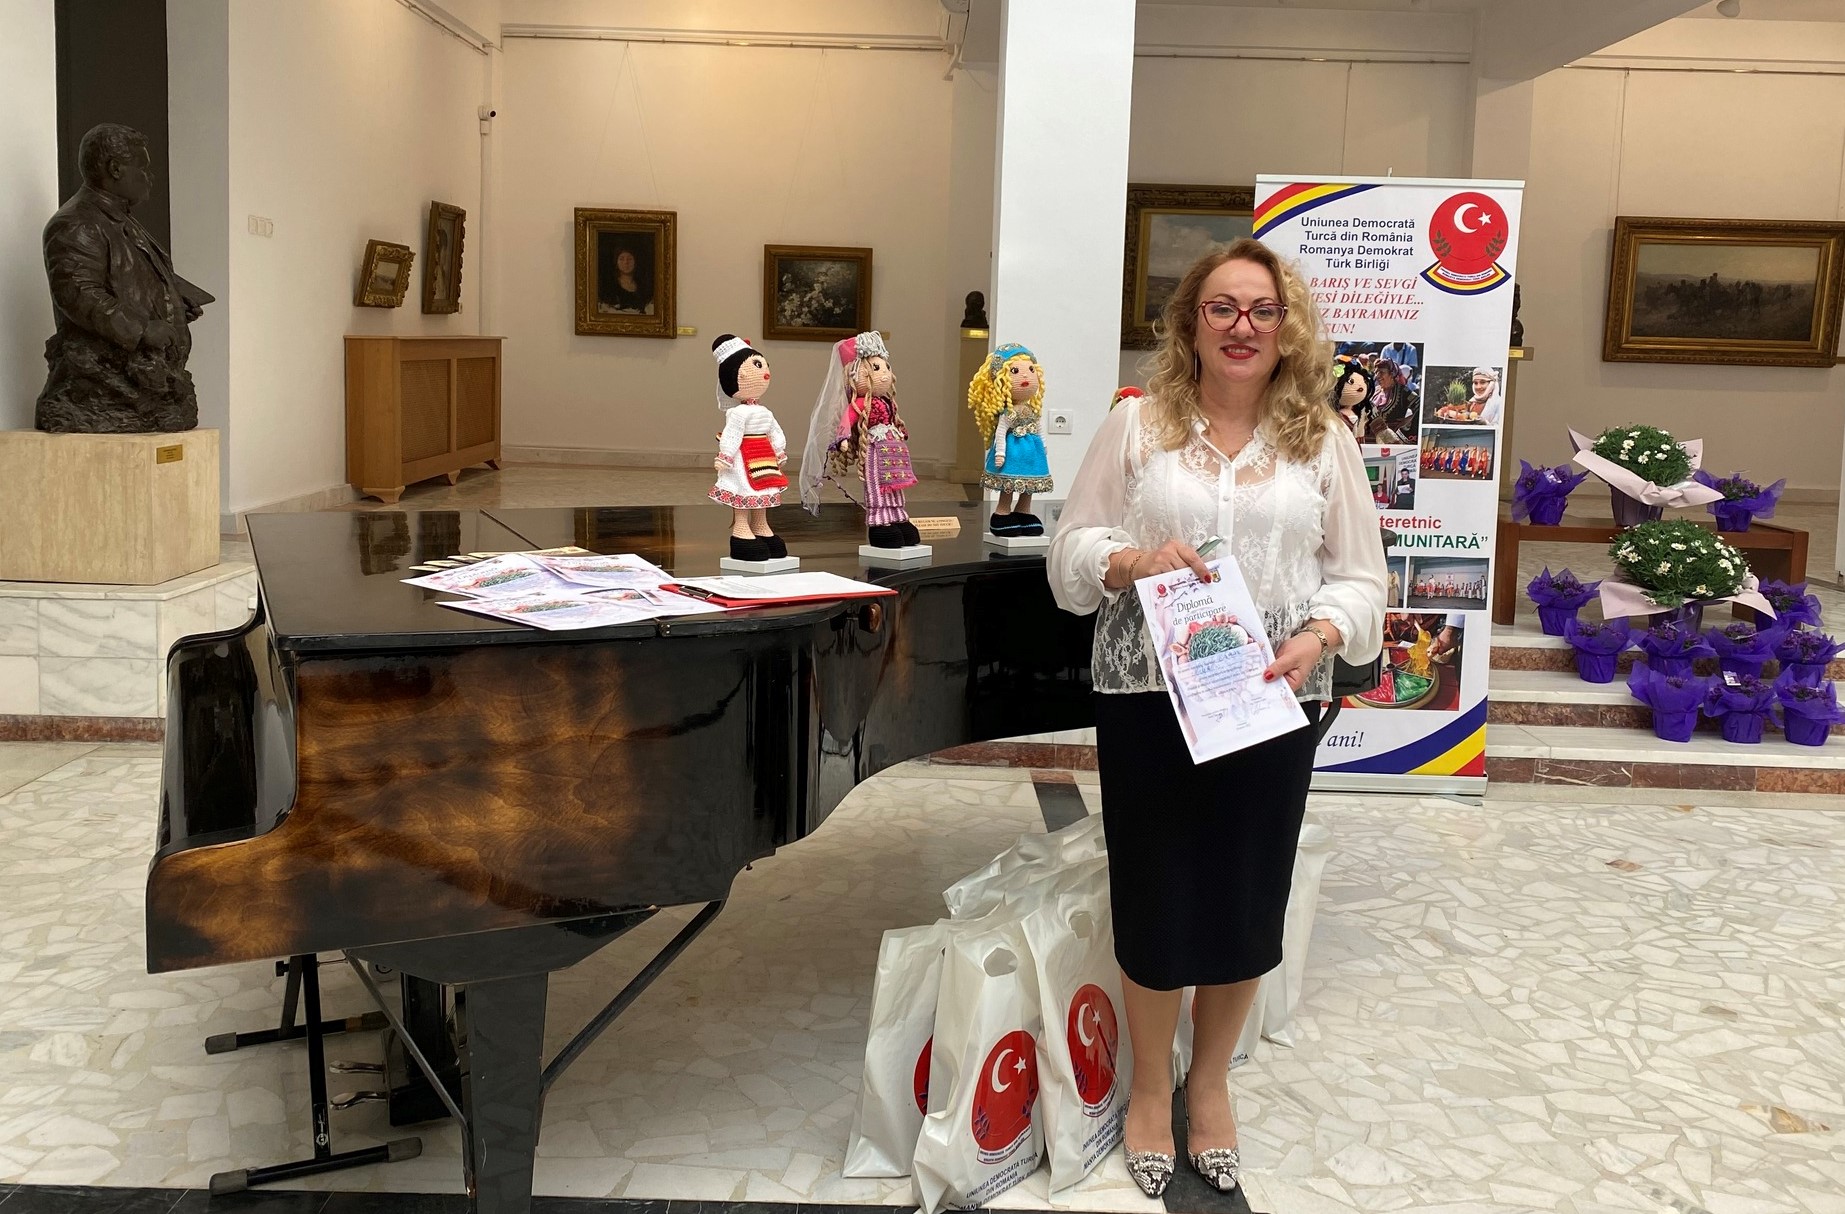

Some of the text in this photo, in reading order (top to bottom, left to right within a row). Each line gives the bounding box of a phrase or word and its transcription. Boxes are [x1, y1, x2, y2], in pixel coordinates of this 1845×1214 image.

[1301, 216, 1415, 229] Uniunea Democrată
[1305, 230, 1413, 242] Turcă din România
[1299, 244, 1414, 257] Romanya Demokrat
[1325, 258, 1390, 271] Türk Birliği
[1309, 276, 1418, 290] BARIŞ VE SEVGİ
[1311, 290, 1424, 305] ESİ DİLEĞİYLE...
[1333, 308, 1419, 320] BAYRAMINIZ
[1320, 323, 1356, 334] SUN!
[1379, 515, 1442, 529] teretnic
[1394, 532, 1488, 549] MUNITARĂ”
[1176, 595, 1214, 613] Diplomă
[1172, 606, 1226, 626] de participare
[1327, 730, 1364, 748] ani!
[966, 1180, 990, 1198] UNIUNEA
[986, 1185, 995, 1196] DIN
